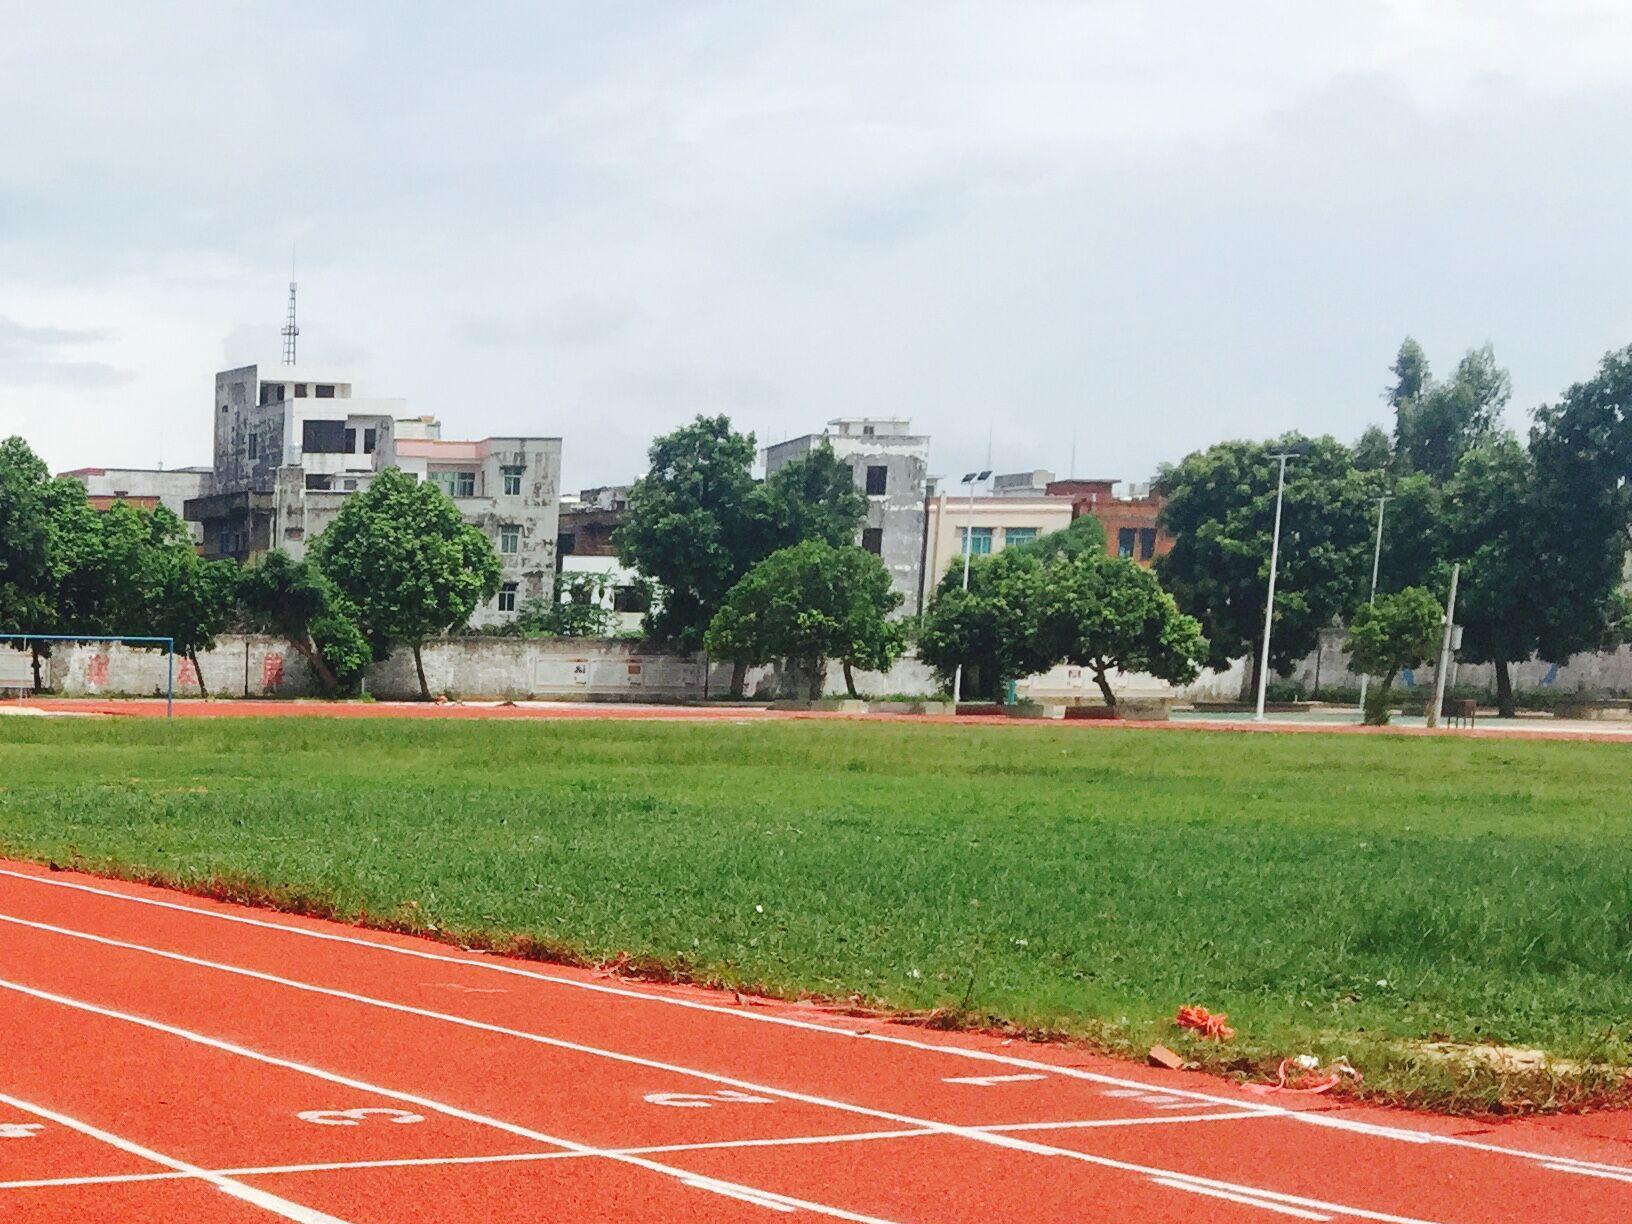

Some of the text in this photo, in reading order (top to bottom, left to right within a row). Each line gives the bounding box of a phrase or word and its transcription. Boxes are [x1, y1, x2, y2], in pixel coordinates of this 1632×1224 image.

[940, 1073, 1050, 1087] 1
[642, 1089, 778, 1108] 2
[295, 1107, 426, 1126] 3
